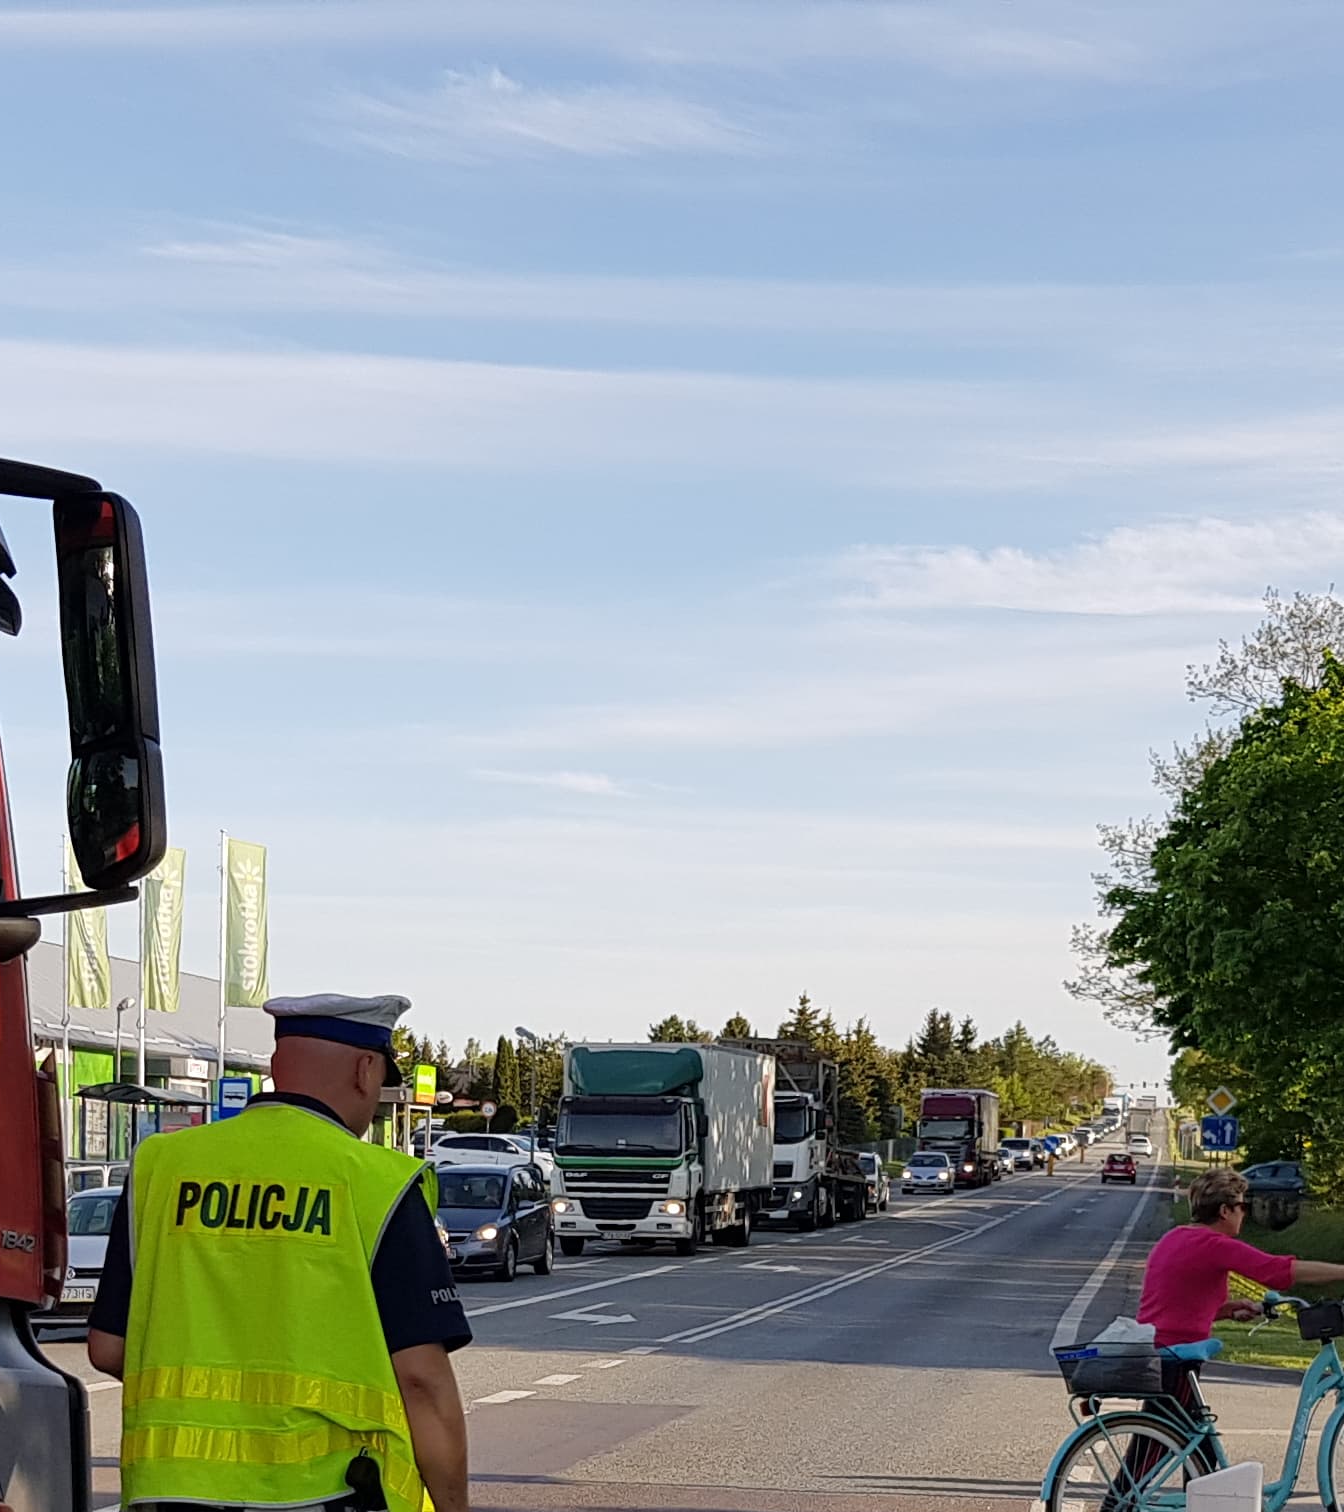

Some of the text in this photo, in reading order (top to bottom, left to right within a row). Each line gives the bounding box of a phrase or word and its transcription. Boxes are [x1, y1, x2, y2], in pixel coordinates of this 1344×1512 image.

[237, 883, 258, 991] stokrotka
[176, 1181, 331, 1236] POLICJA
[0, 1229, 36, 1254] 1842
